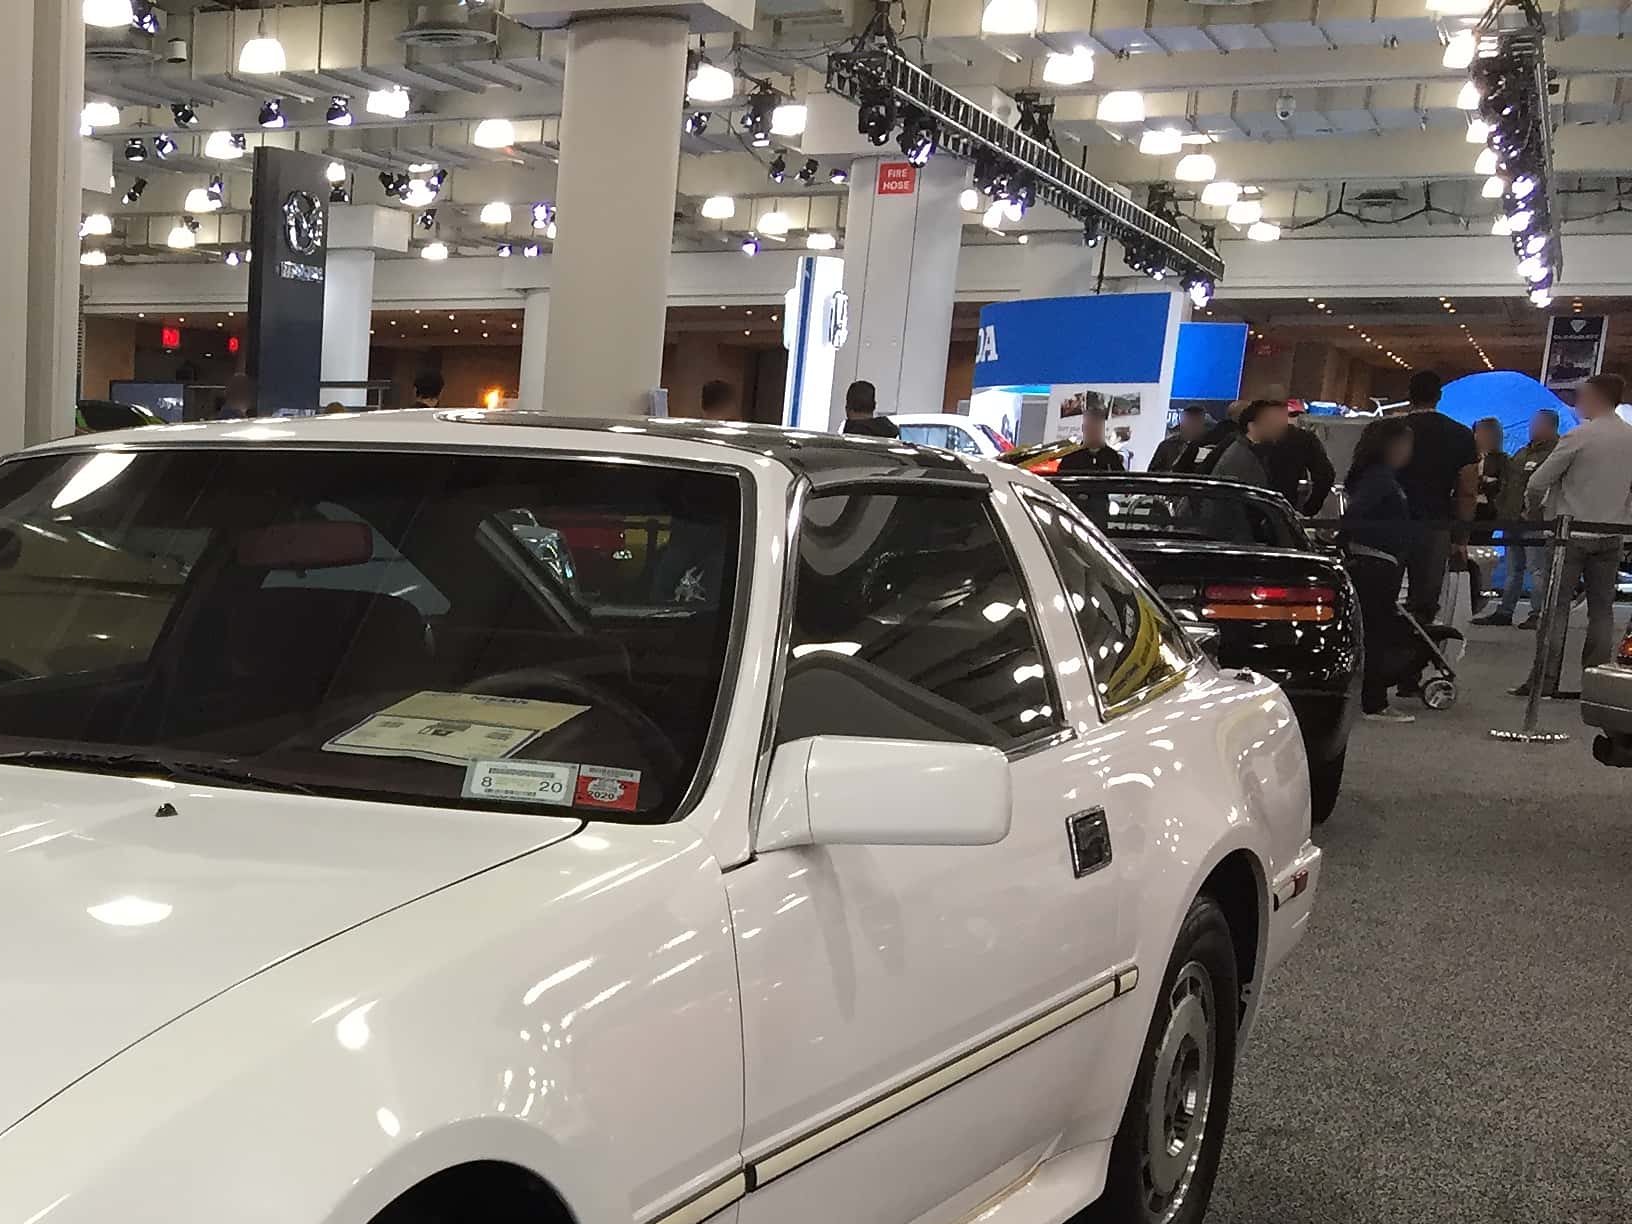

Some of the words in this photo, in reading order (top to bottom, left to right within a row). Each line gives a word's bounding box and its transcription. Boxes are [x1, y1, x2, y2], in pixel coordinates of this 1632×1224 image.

[887, 168, 909, 178] FIRE
[882, 180, 911, 191] HOSE
[480, 776, 493, 788] 8
[539, 781, 563, 793] 20
[588, 791, 615, 800] 2020
